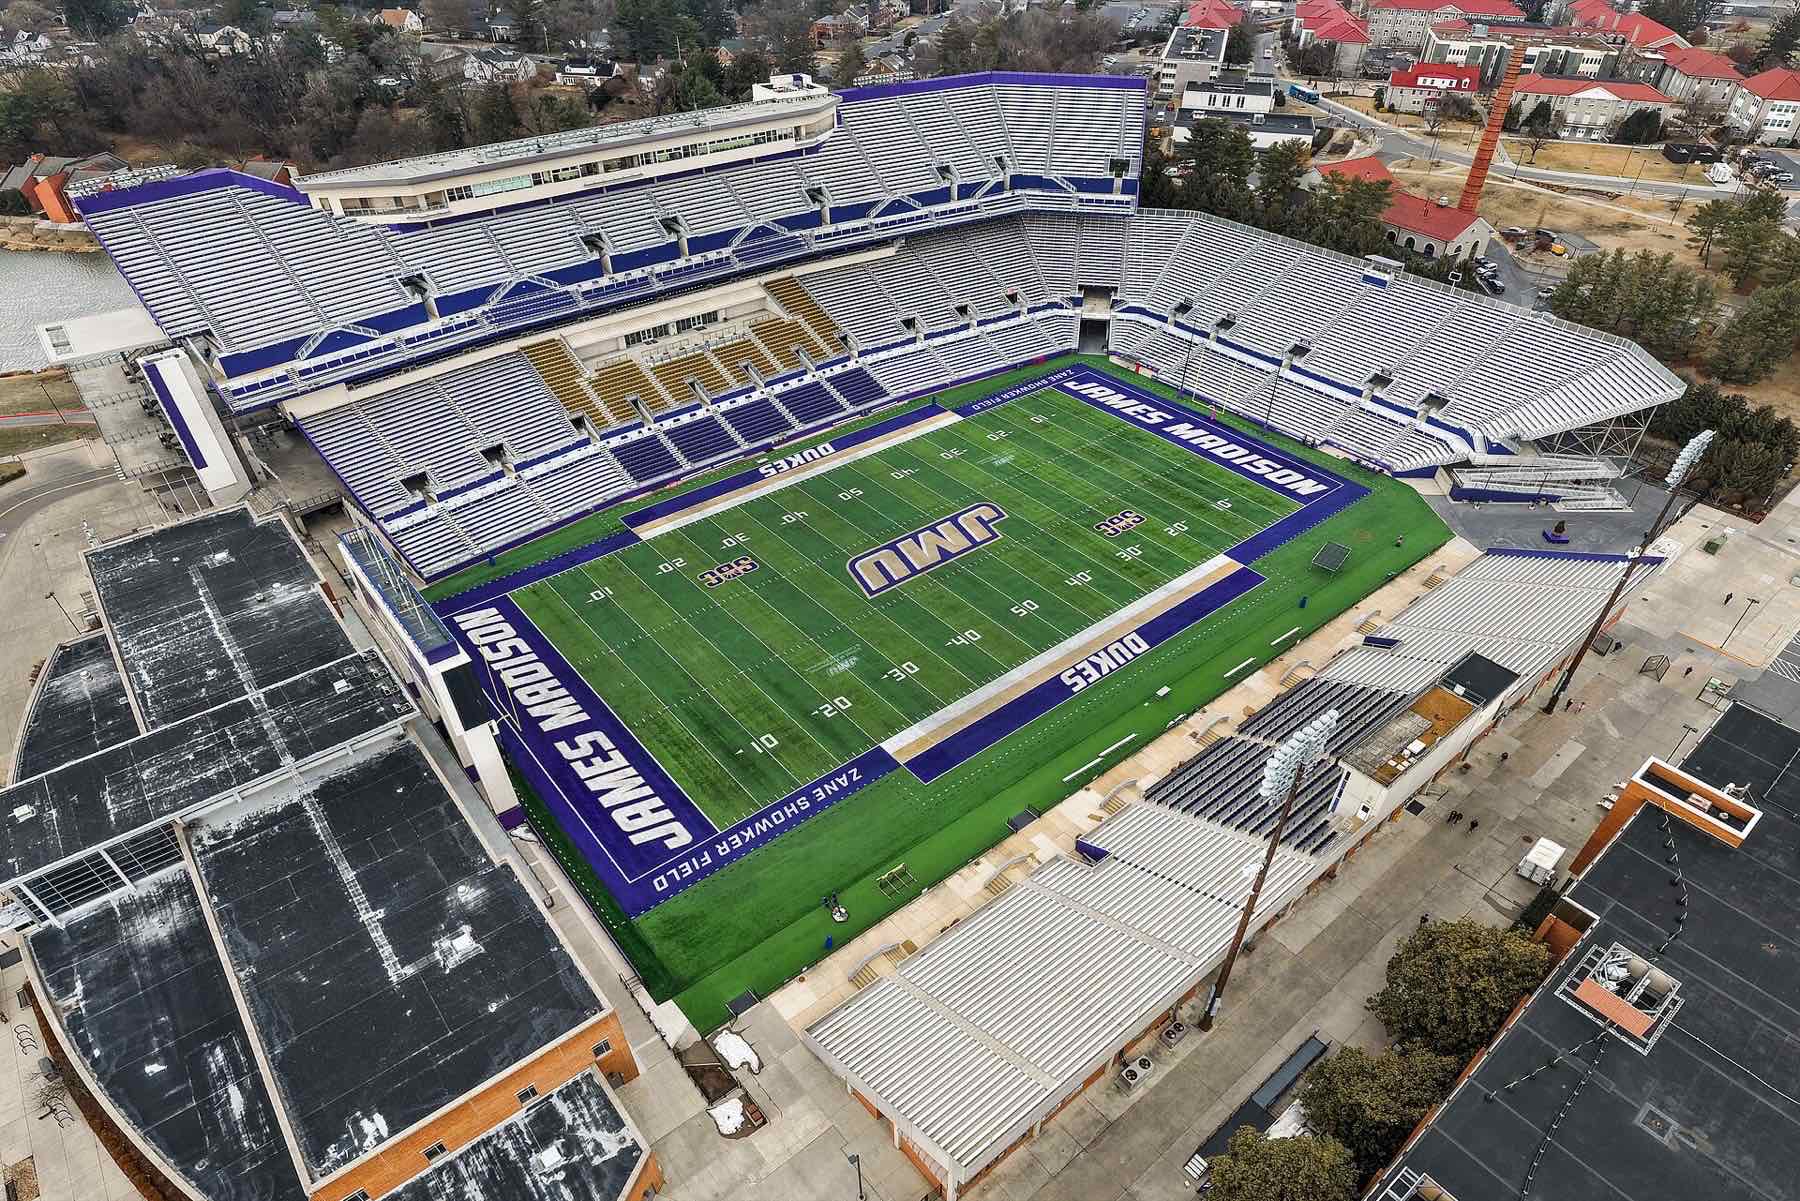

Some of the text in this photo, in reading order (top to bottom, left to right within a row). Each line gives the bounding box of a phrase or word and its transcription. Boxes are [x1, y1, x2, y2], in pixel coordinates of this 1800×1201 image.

[972, 369, 1074, 410] ZANE SHOWKER FIELD
[1030, 414, 1049, 424] 10
[986, 430, 1009, 441] 20
[1063, 380, 1329, 496] JAMES MADISON
[759, 442, 836, 478] DUKES
[940, 447, 964, 460] 30
[890, 467, 914, 481] 40
[838, 487, 864, 501] 50
[1213, 499, 1233, 511] 10
[781, 510, 809, 524] 40
[1163, 522, 1189, 537] 20
[722, 532, 751, 548] 30
[853, 505, 1000, 592] JMU
[1115, 546, 1144, 562] 30
[658, 557, 687, 574] 20
[1064, 571, 1092, 586] 40
[590, 586, 613, 601] 10
[1010, 599, 1040, 617] 50
[951, 629, 982, 646] 40
[1060, 631, 1151, 693] DUKES
[887, 661, 920, 682] 30
[818, 696, 852, 718] 20
[453, 607, 693, 850] JAMES MADISON
[750, 733, 779, 753] 10
[653, 767, 863, 892] ZANE SHOWKER FIELD
